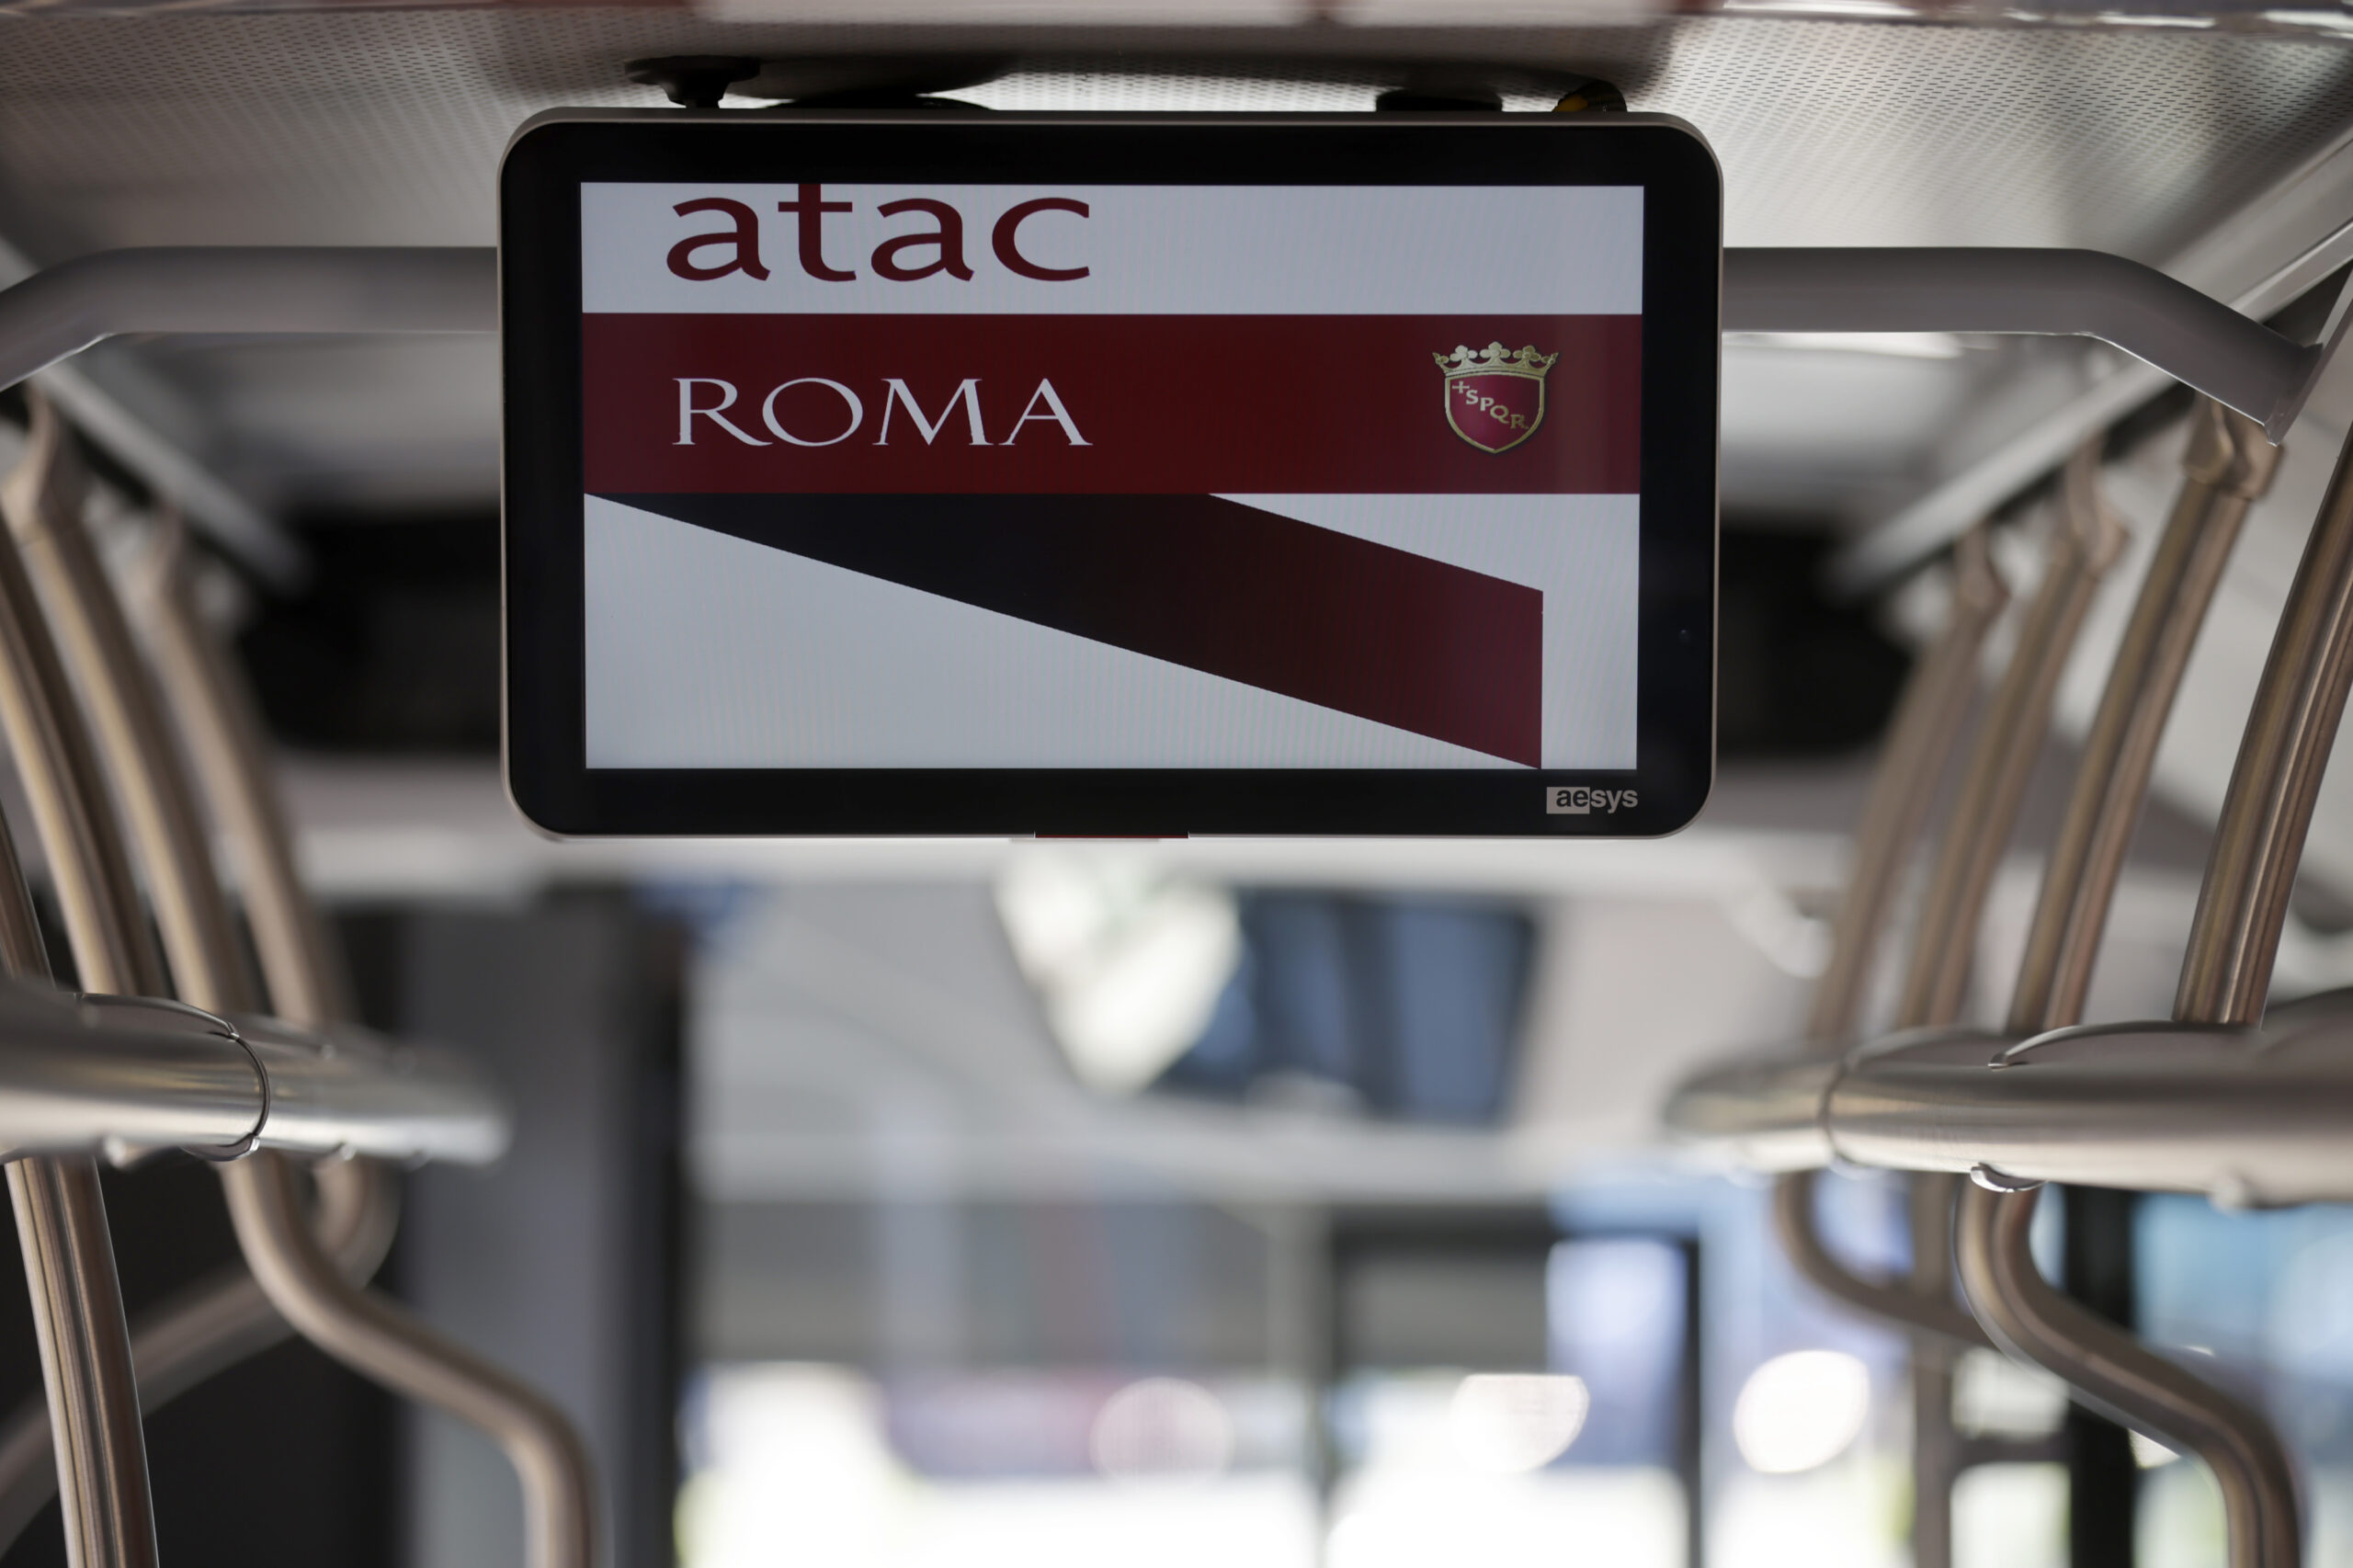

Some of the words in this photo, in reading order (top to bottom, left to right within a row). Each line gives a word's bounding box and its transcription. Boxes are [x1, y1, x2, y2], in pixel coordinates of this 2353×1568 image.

[665, 184, 1091, 282] atac
[672, 377, 1094, 447] ROMA
[1555, 789, 1639, 814] aesys
